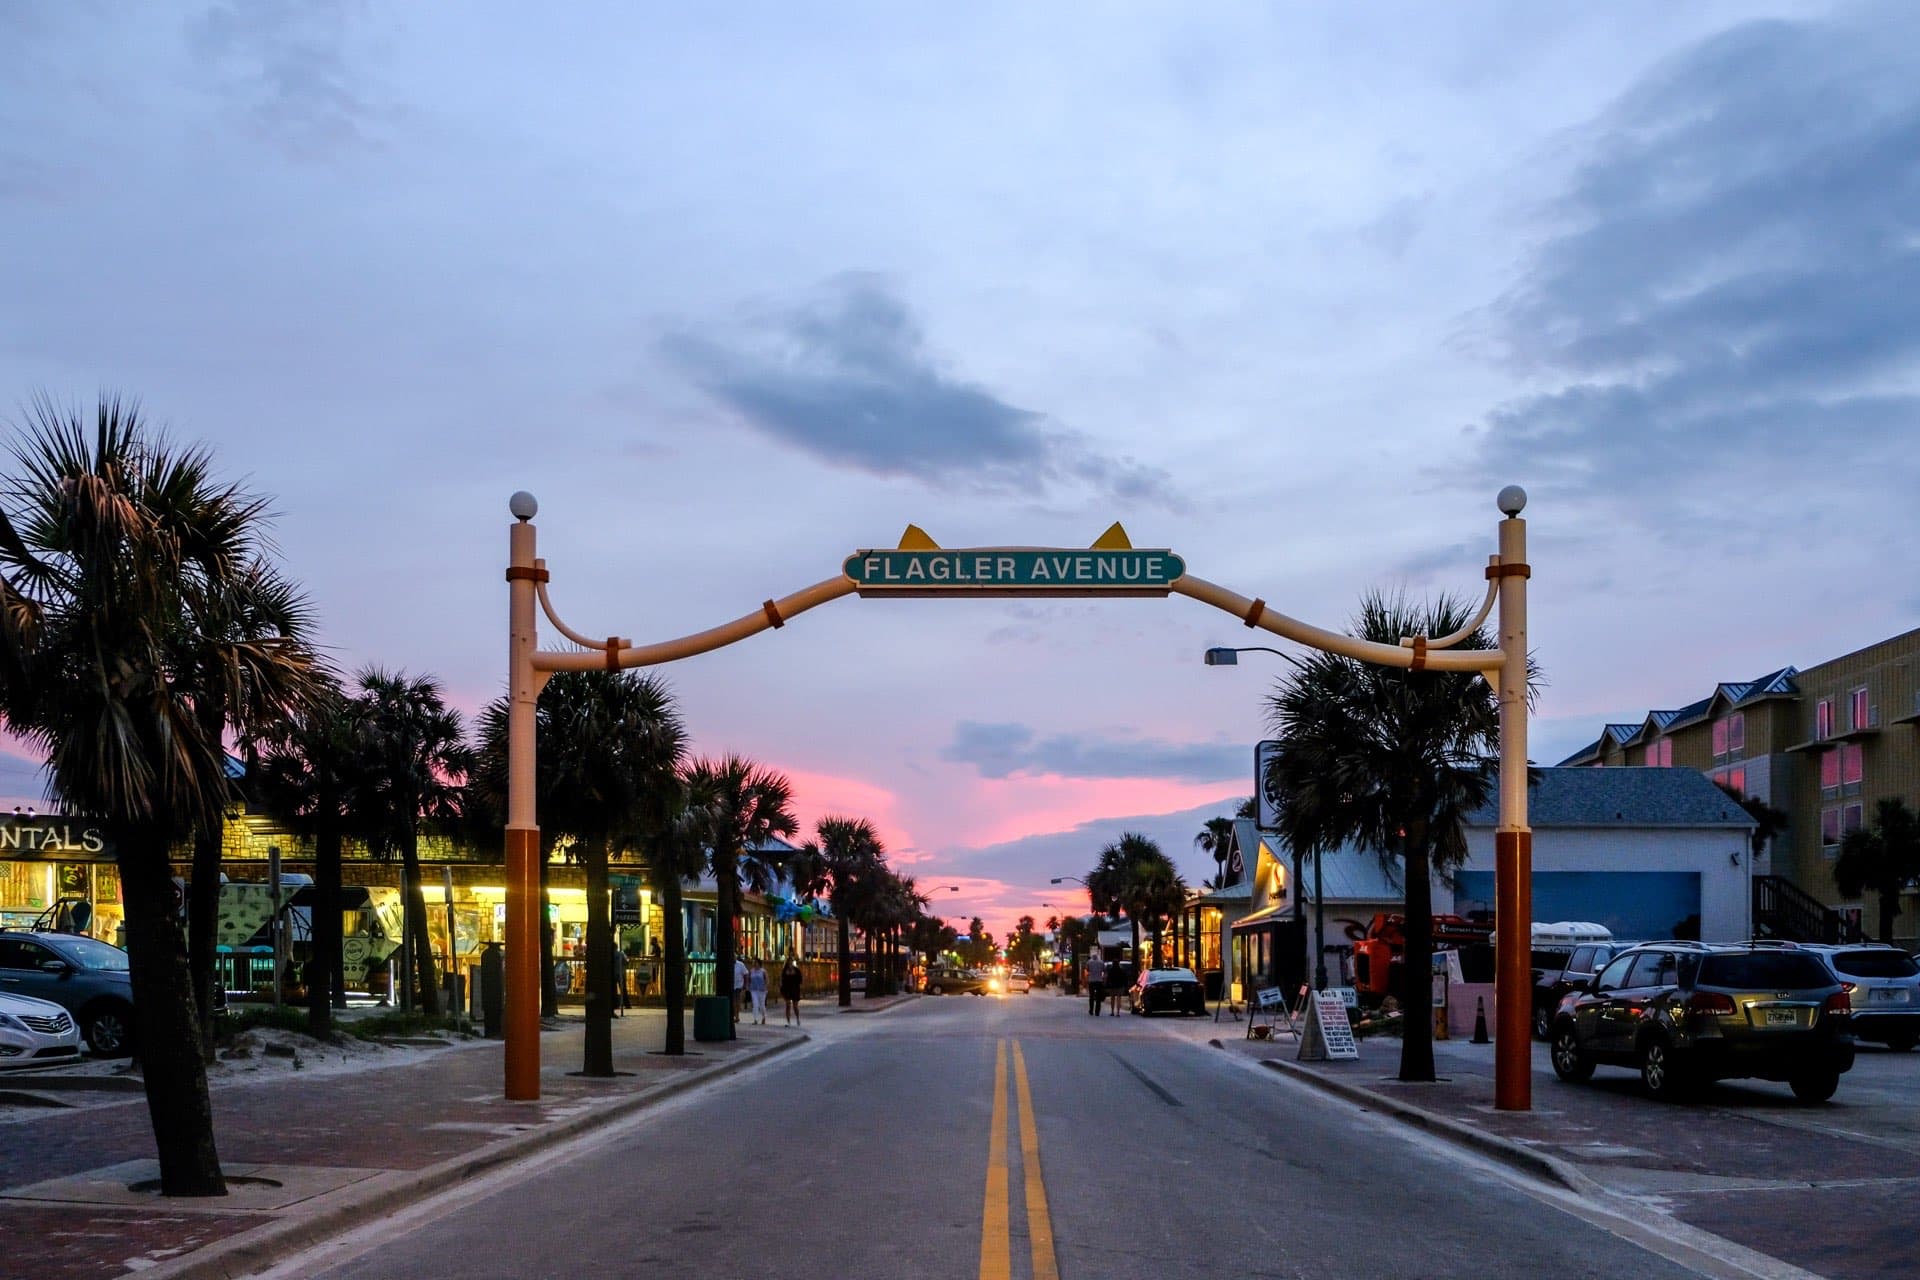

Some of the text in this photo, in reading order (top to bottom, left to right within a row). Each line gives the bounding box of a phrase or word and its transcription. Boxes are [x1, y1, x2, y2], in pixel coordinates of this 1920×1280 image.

[864, 557, 1164, 580] FLAGLER AVENUE
[0, 825, 104, 852] NTALS
